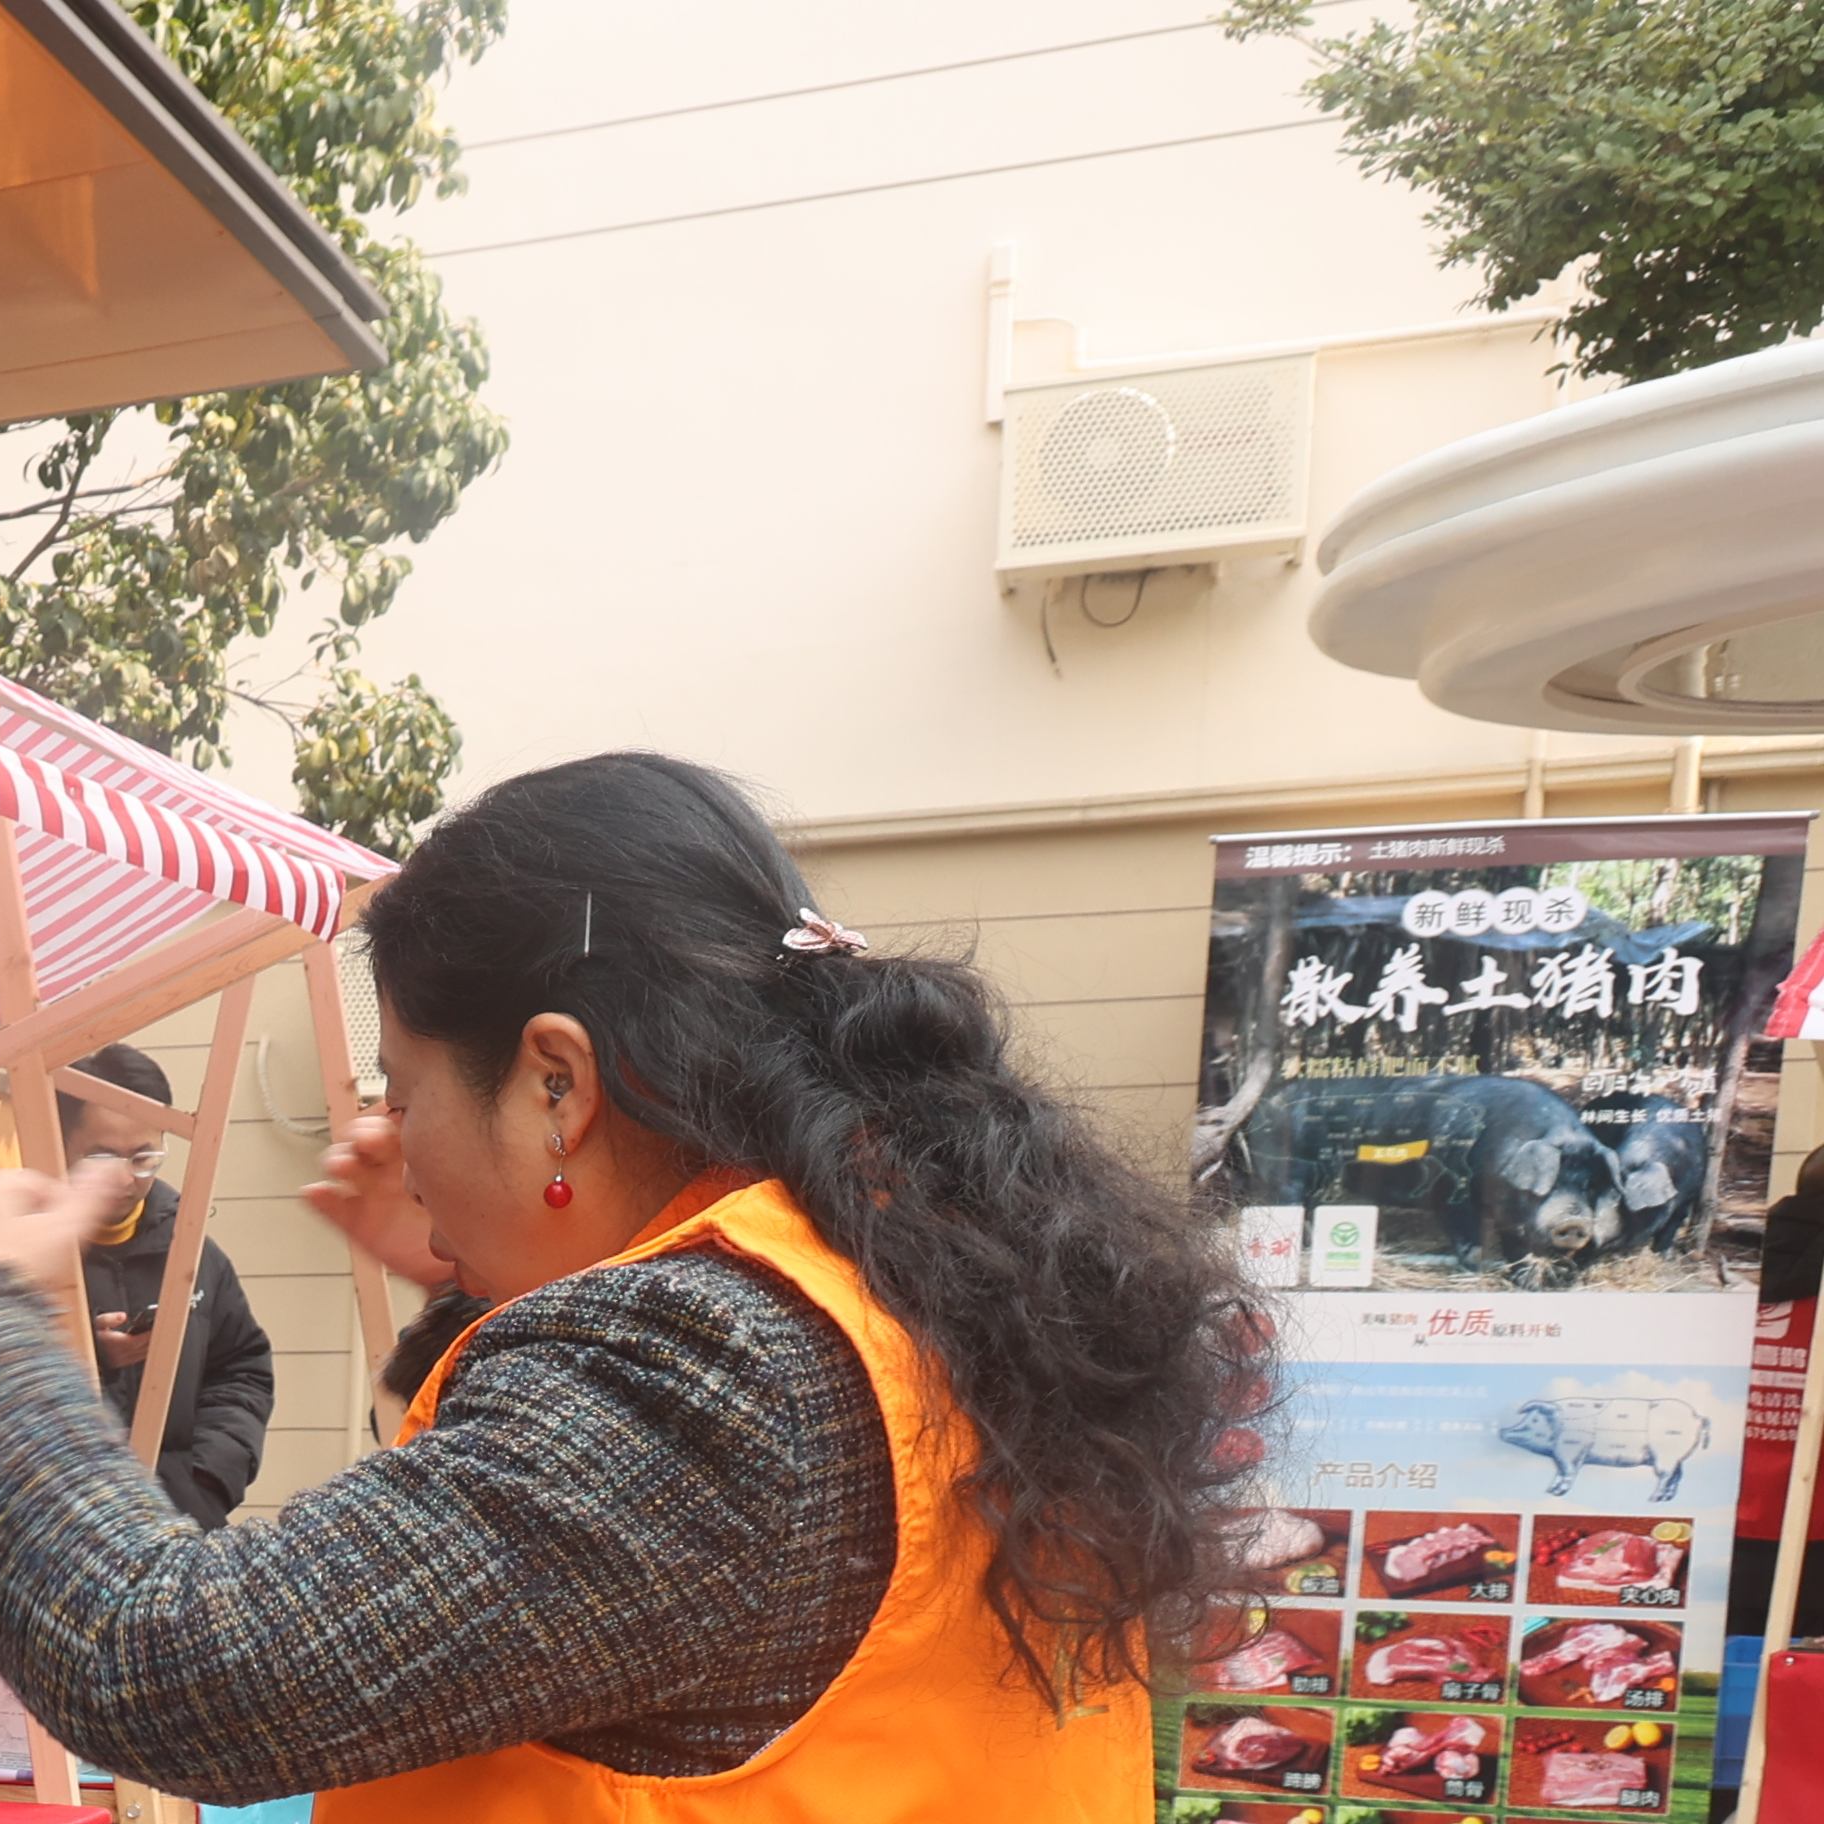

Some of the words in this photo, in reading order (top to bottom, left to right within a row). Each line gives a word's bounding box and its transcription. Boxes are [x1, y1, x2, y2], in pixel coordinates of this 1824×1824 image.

[1414, 897, 1576, 930] 新鲜现杀
[1280, 941, 1705, 1033] 散养土猪肉
[1427, 1308, 1496, 1337] 优质
[1312, 1461, 1439, 1490] 产品介绍
[1469, 1582, 1509, 1601] 大排
[1619, 1587, 1682, 1606] 夹心肉
